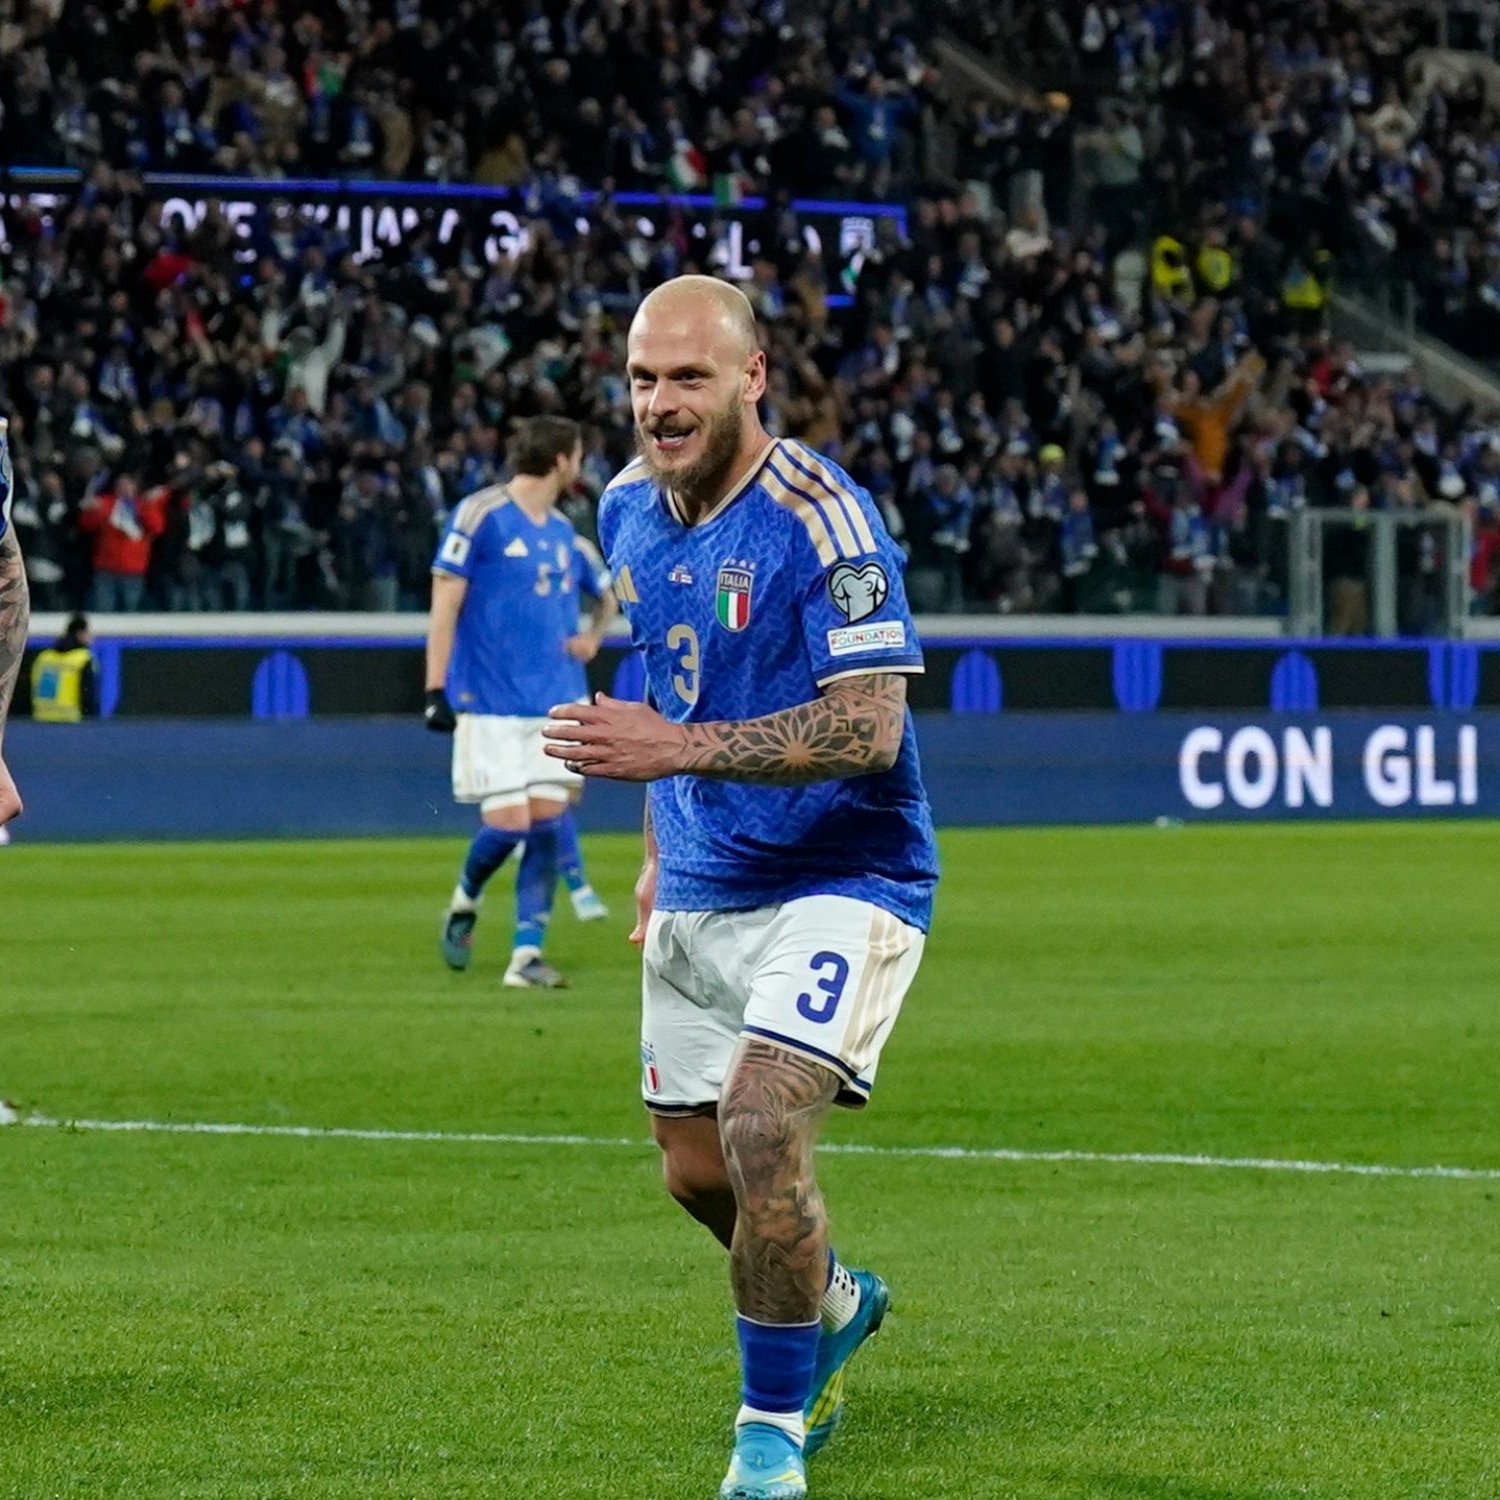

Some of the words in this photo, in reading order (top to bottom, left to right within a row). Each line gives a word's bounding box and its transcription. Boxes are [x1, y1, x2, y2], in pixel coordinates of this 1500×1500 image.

[721, 572, 749, 589] ITALIA
[667, 623, 700, 705] 3
[1179, 725, 1333, 809] CON
[1363, 724, 1478, 807] GLI
[797, 950, 849, 1024] 3
